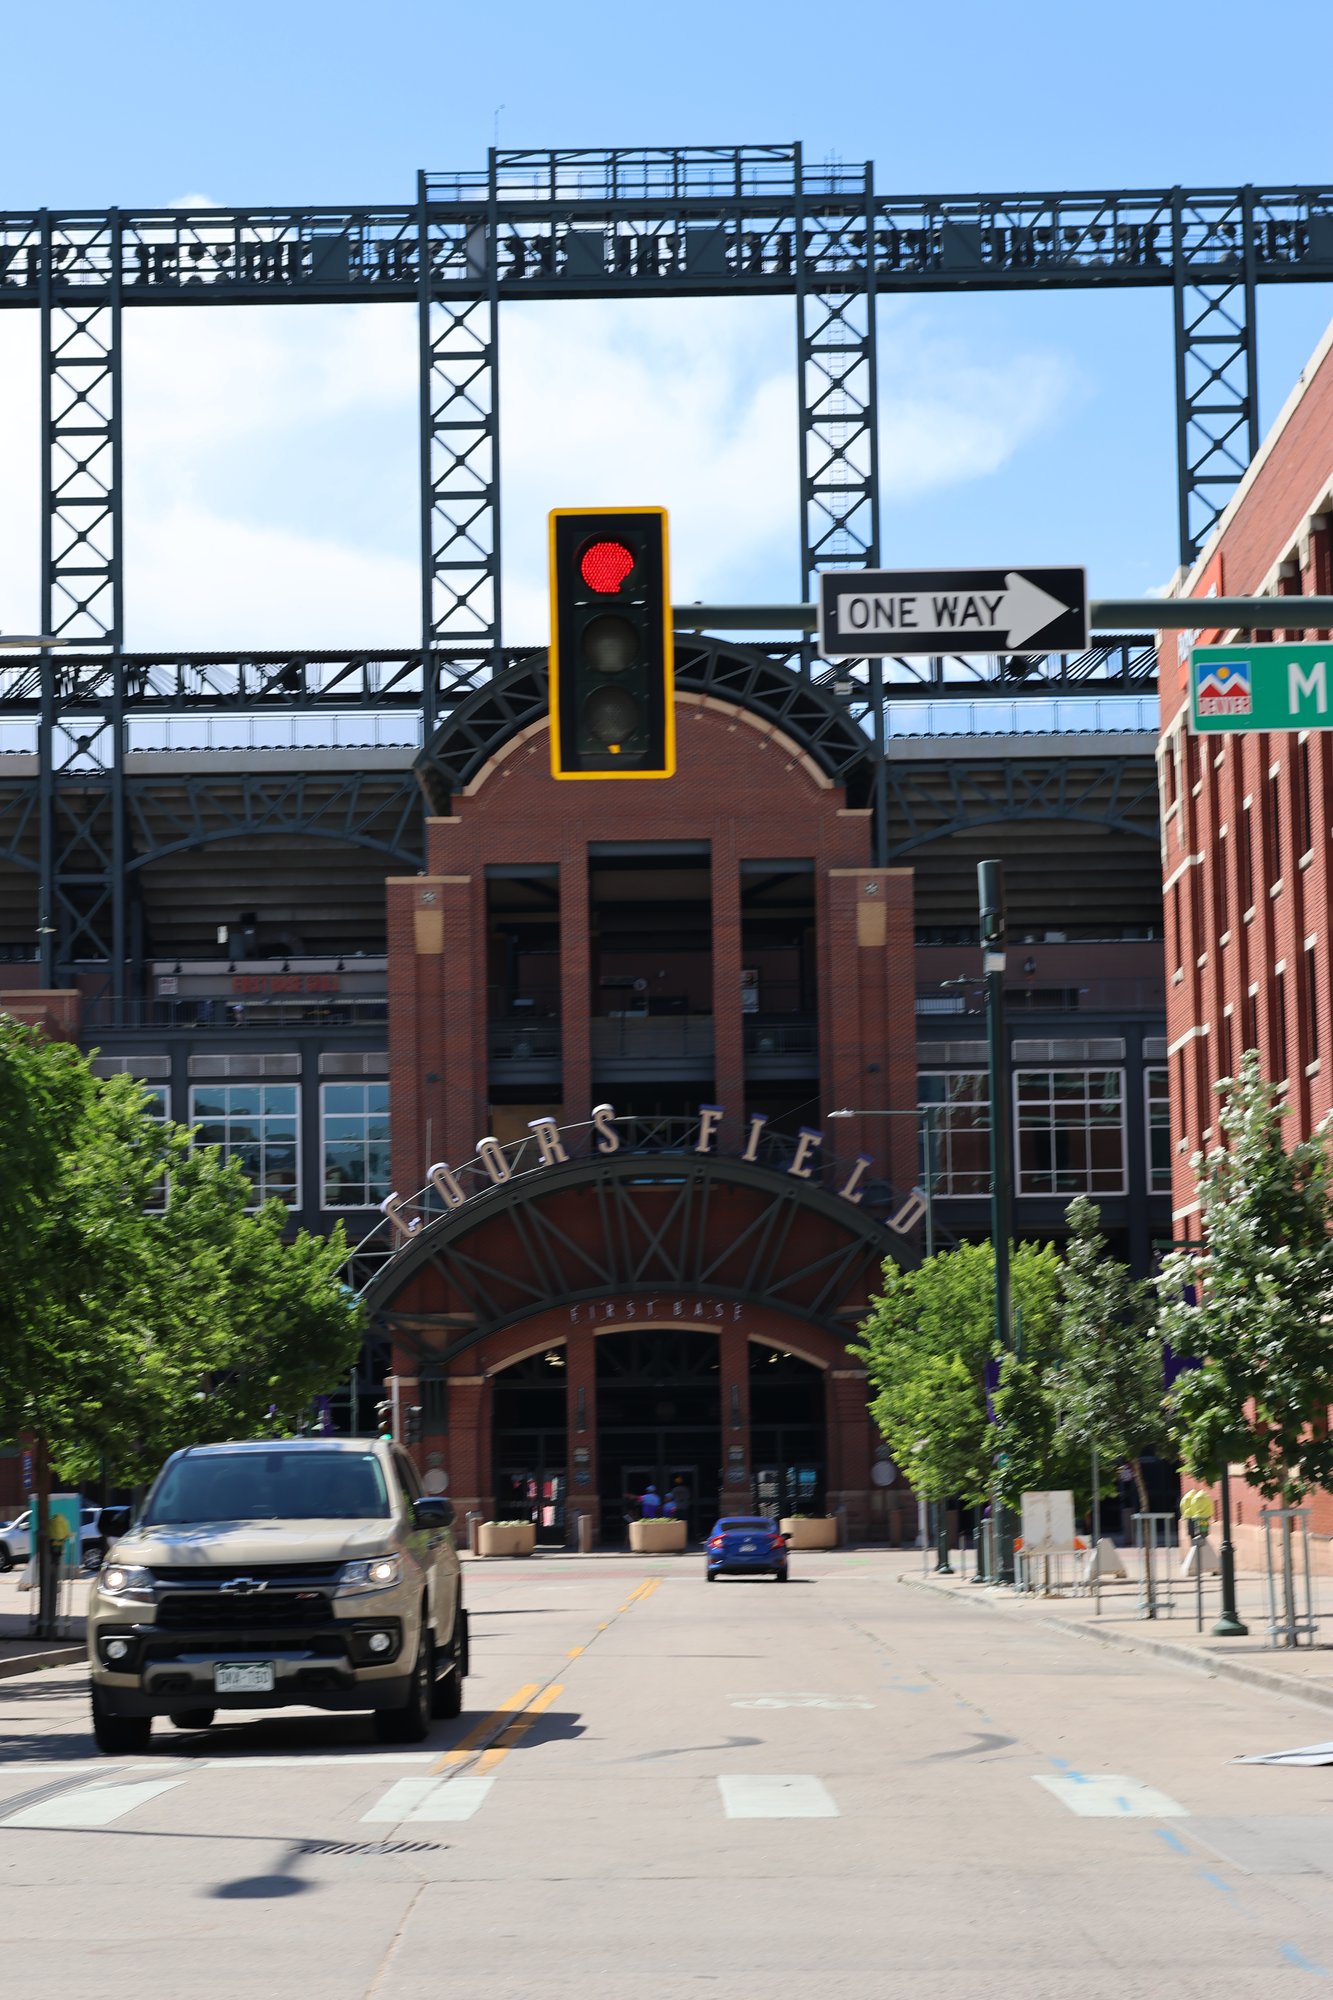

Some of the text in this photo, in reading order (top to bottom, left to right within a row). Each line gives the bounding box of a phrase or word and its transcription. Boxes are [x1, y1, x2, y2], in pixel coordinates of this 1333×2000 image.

[850, 595, 1005, 628] ONE WAY
[1200, 698, 1252, 715] DENVER
[380, 1103, 928, 1238] COORS FIELD
[570, 1300, 744, 1323] FIRST BASE
